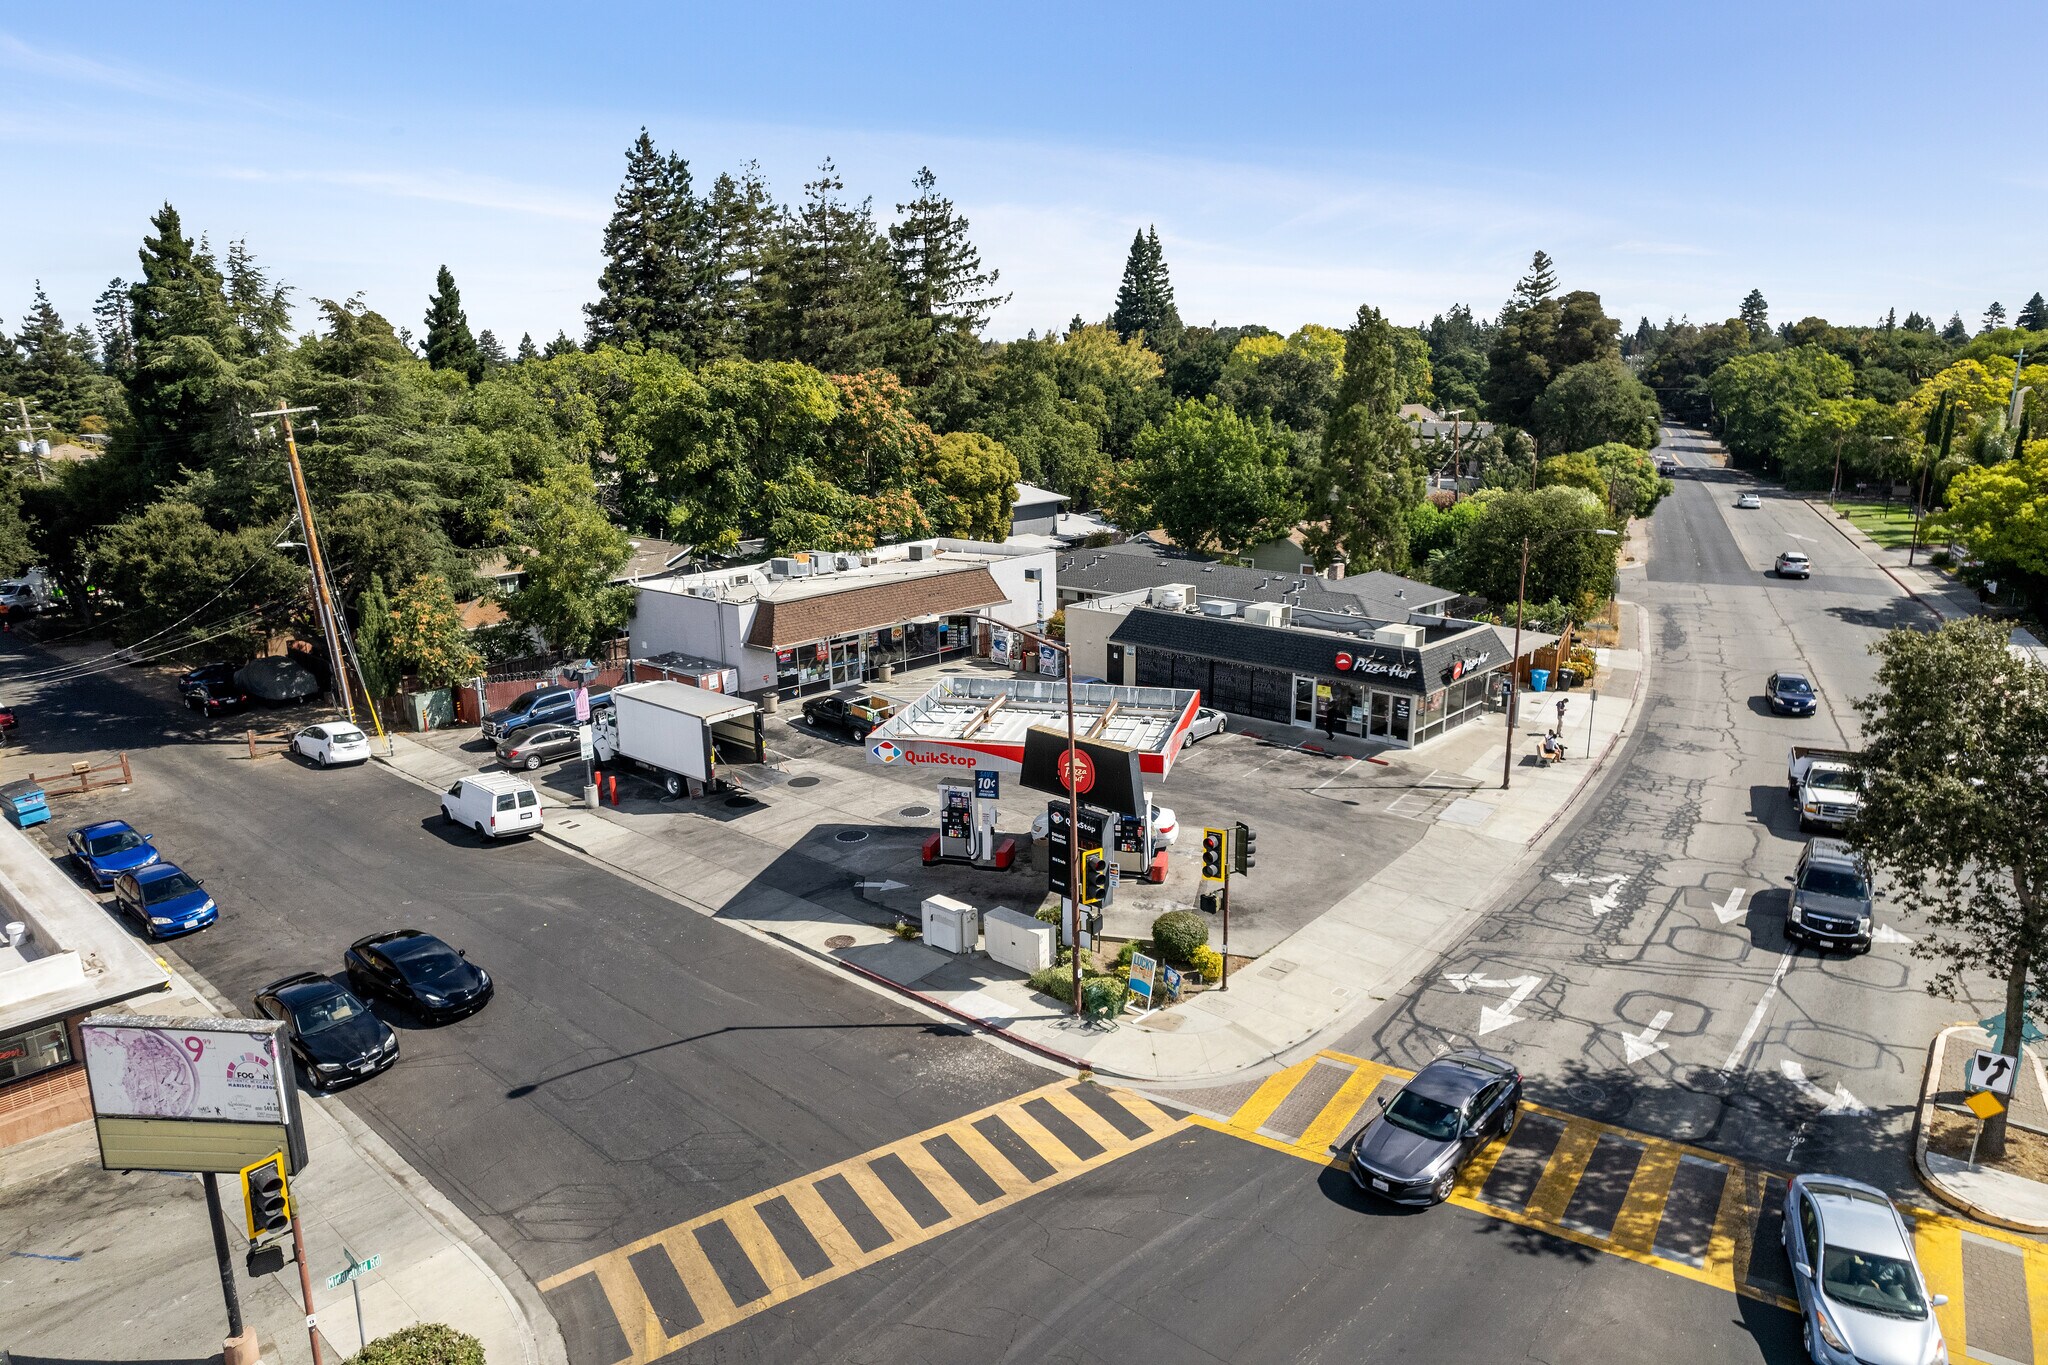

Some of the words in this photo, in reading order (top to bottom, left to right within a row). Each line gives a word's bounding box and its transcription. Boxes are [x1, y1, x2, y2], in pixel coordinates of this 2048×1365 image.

[1353, 657, 1388, 675] Pizza
[1388, 663, 1417, 679] Hut
[1462, 658, 1478, 674] Pizza
[1477, 652, 1490, 666] Hut
[905, 751, 976, 768] QuikStop
[370, 1255, 380, 1270] Rd
